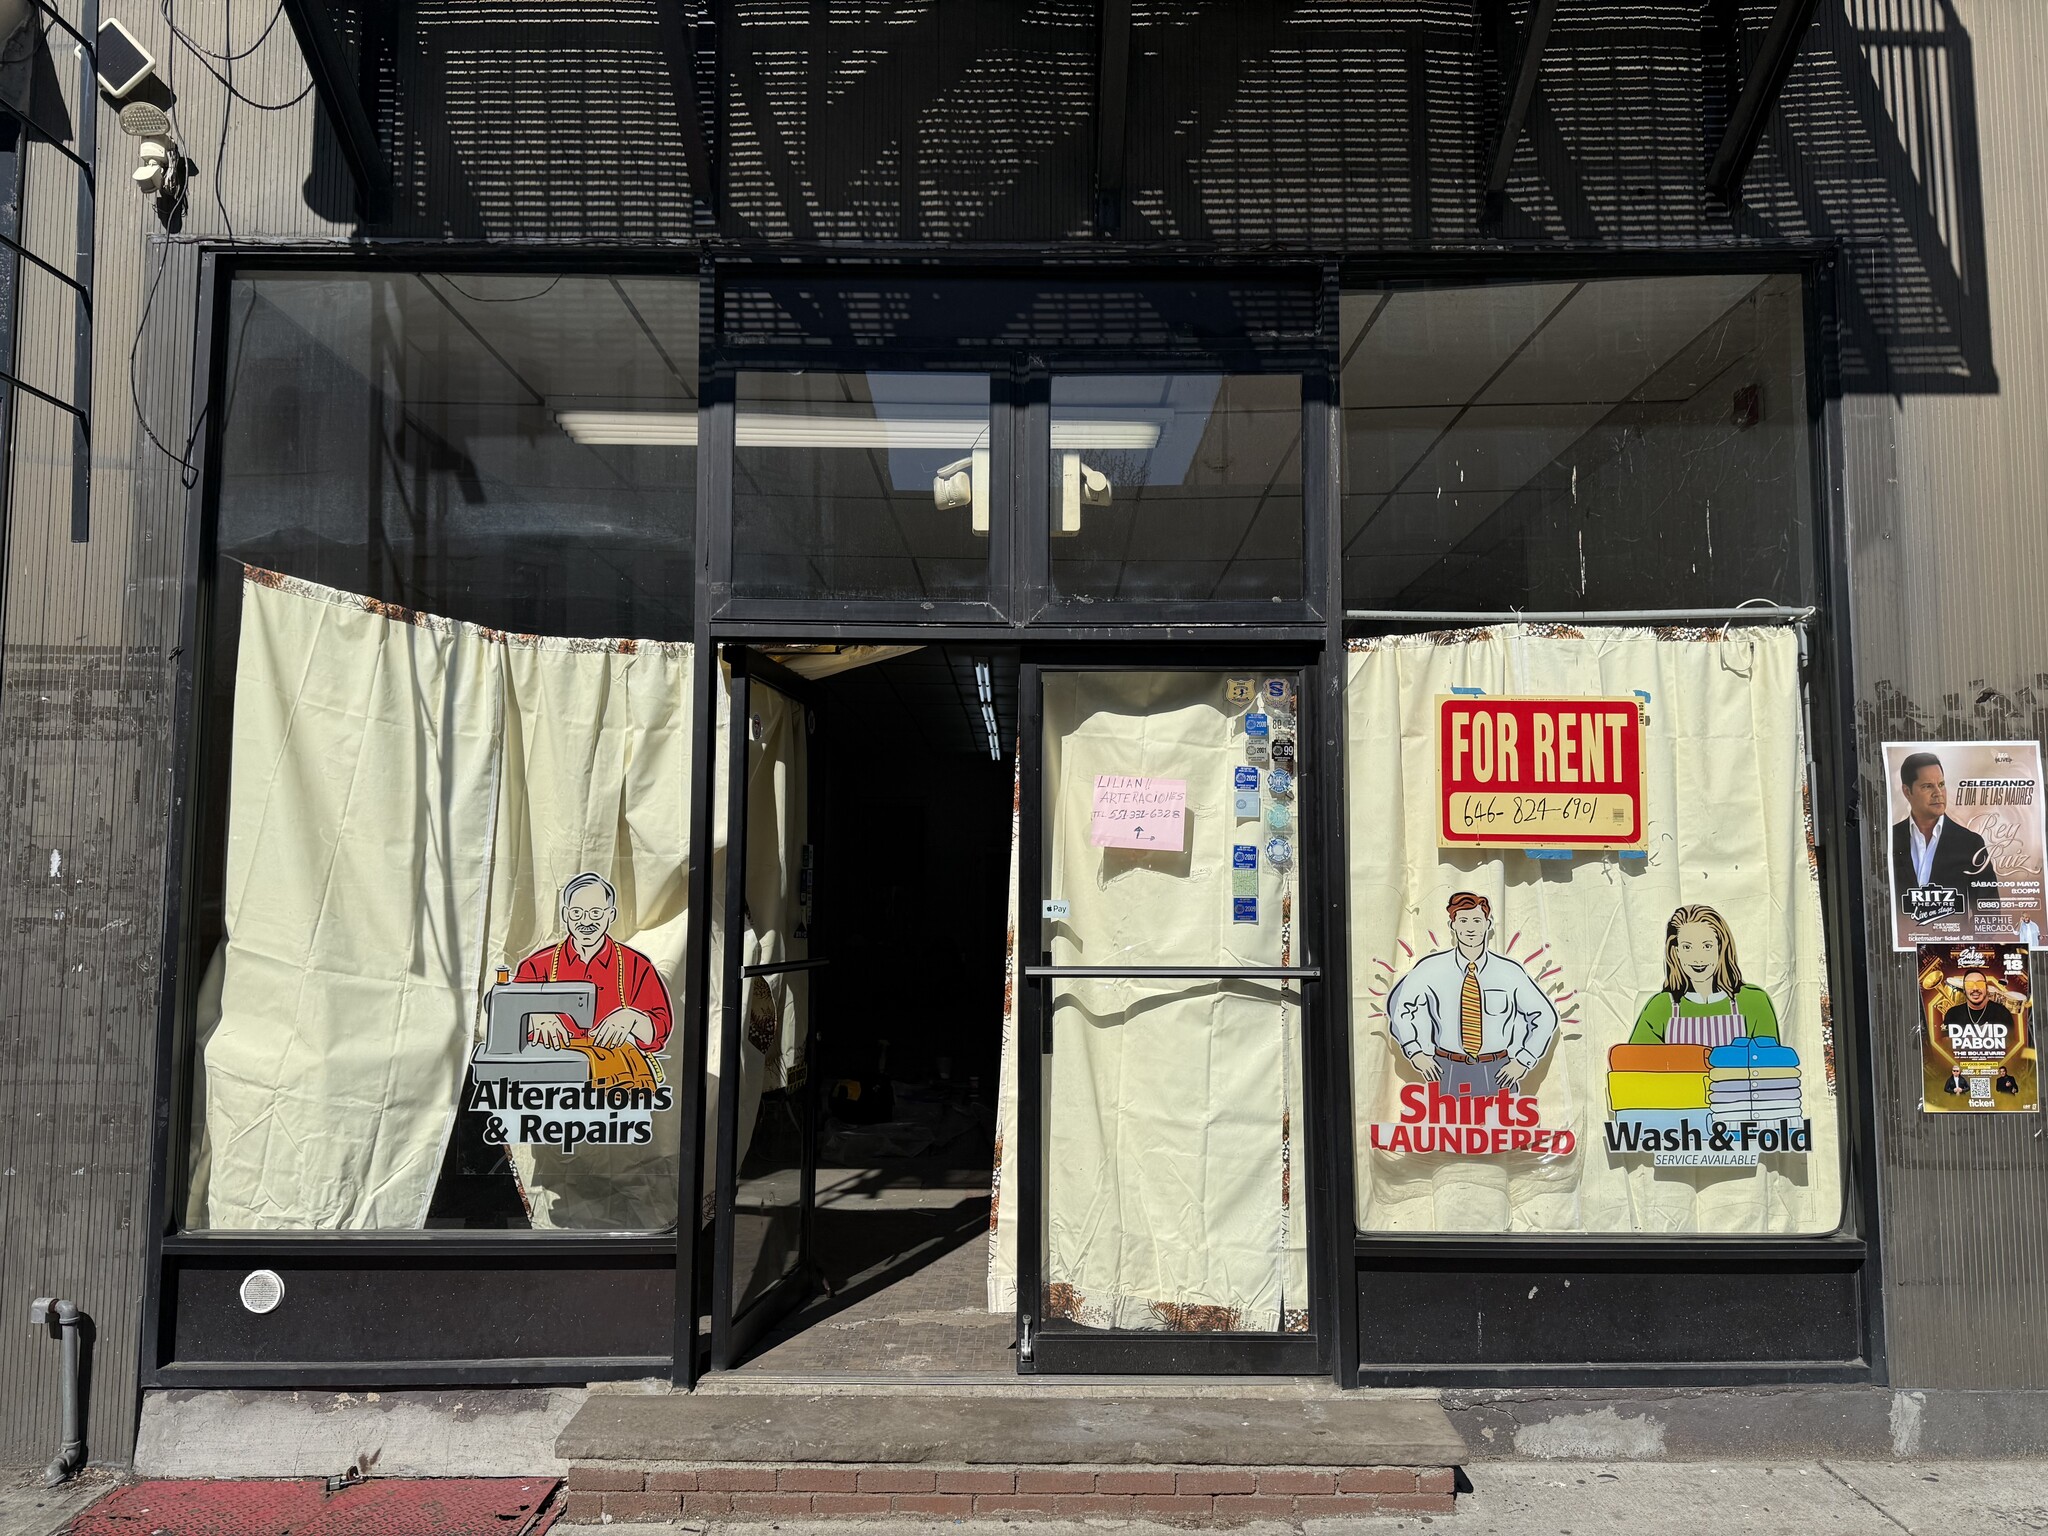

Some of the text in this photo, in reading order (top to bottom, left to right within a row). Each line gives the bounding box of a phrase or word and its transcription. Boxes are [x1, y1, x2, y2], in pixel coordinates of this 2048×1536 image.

[1283, 746, 1294, 756] 99
[1452, 711, 1628, 783] FOR RENT
[1955, 787, 1964, 806] EL
[1979, 787, 1991, 806] DE
[1990, 787, 2004, 806] LAS
[2003, 787, 2034, 806] MADRES
[1967, 812, 2022, 848] Rey
[1963, 840, 2042, 877] Ruiz
[1910, 890, 1956, 902] RITZ
[1053, 905, 1067, 914] Pay
[1911, 906, 1929, 920] Live
[1974, 924, 2014, 932] MERCADO
[1959, 949, 1985, 960] Salsa
[2003, 960, 2023, 970] 18
[1948, 1023, 2008, 1038] DAVID
[1951, 1037, 2006, 1049] PABON
[470, 1076, 673, 1110] Alterations
[1400, 1081, 1540, 1127] Shirts
[484, 1112, 651, 1153] & Repairs
[1370, 1124, 1577, 1154] LAUNDERED
[1604, 1118, 1813, 1152] Wash & Fold
[1655, 1154, 1757, 1165] SERVICE AVAILABLE
